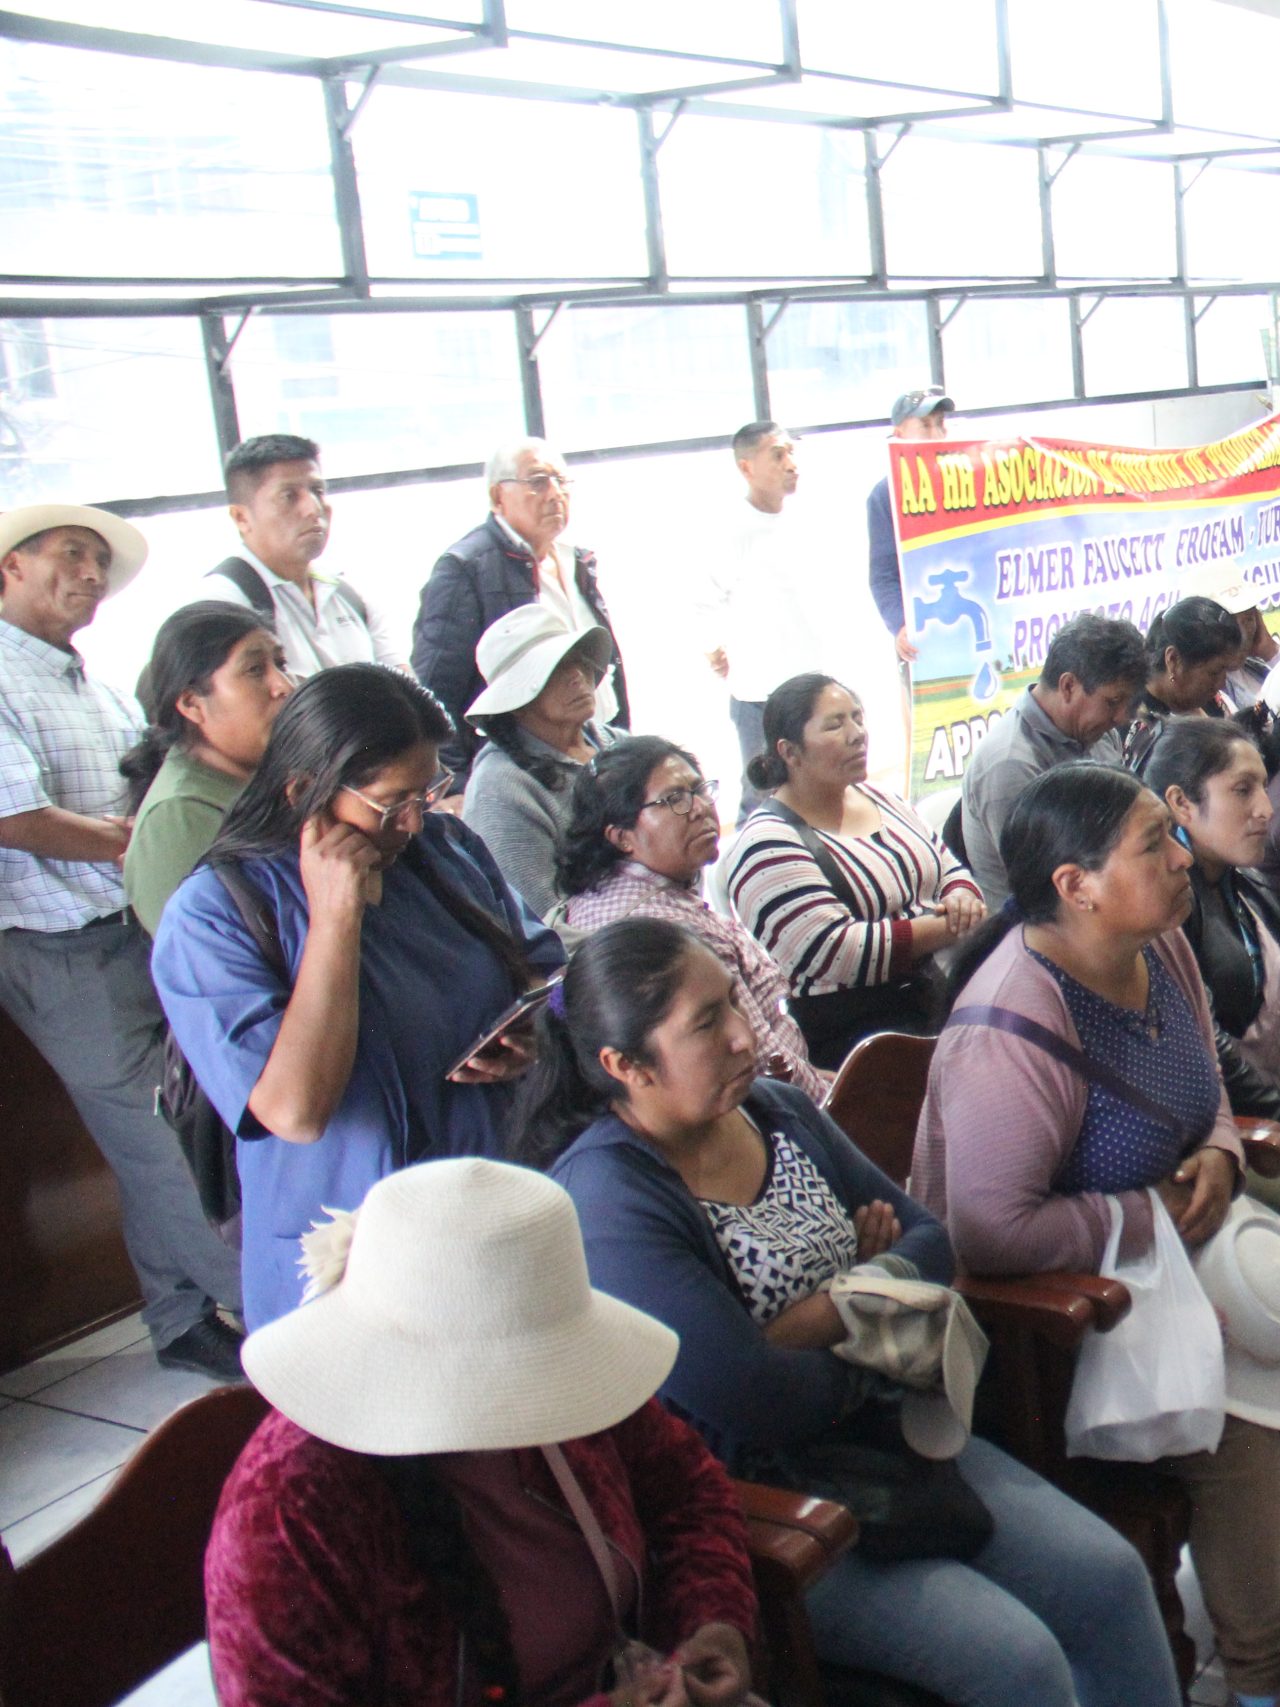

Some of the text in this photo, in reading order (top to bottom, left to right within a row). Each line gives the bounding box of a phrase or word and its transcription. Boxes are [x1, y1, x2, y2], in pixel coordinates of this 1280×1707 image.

[900, 453, 937, 515] AA
[936, 452, 976, 511] HH
[981, 446, 1099, 507] ASOCIACION
[996, 546, 1075, 600] ELMER
[1083, 532, 1166, 586] FAUCETT
